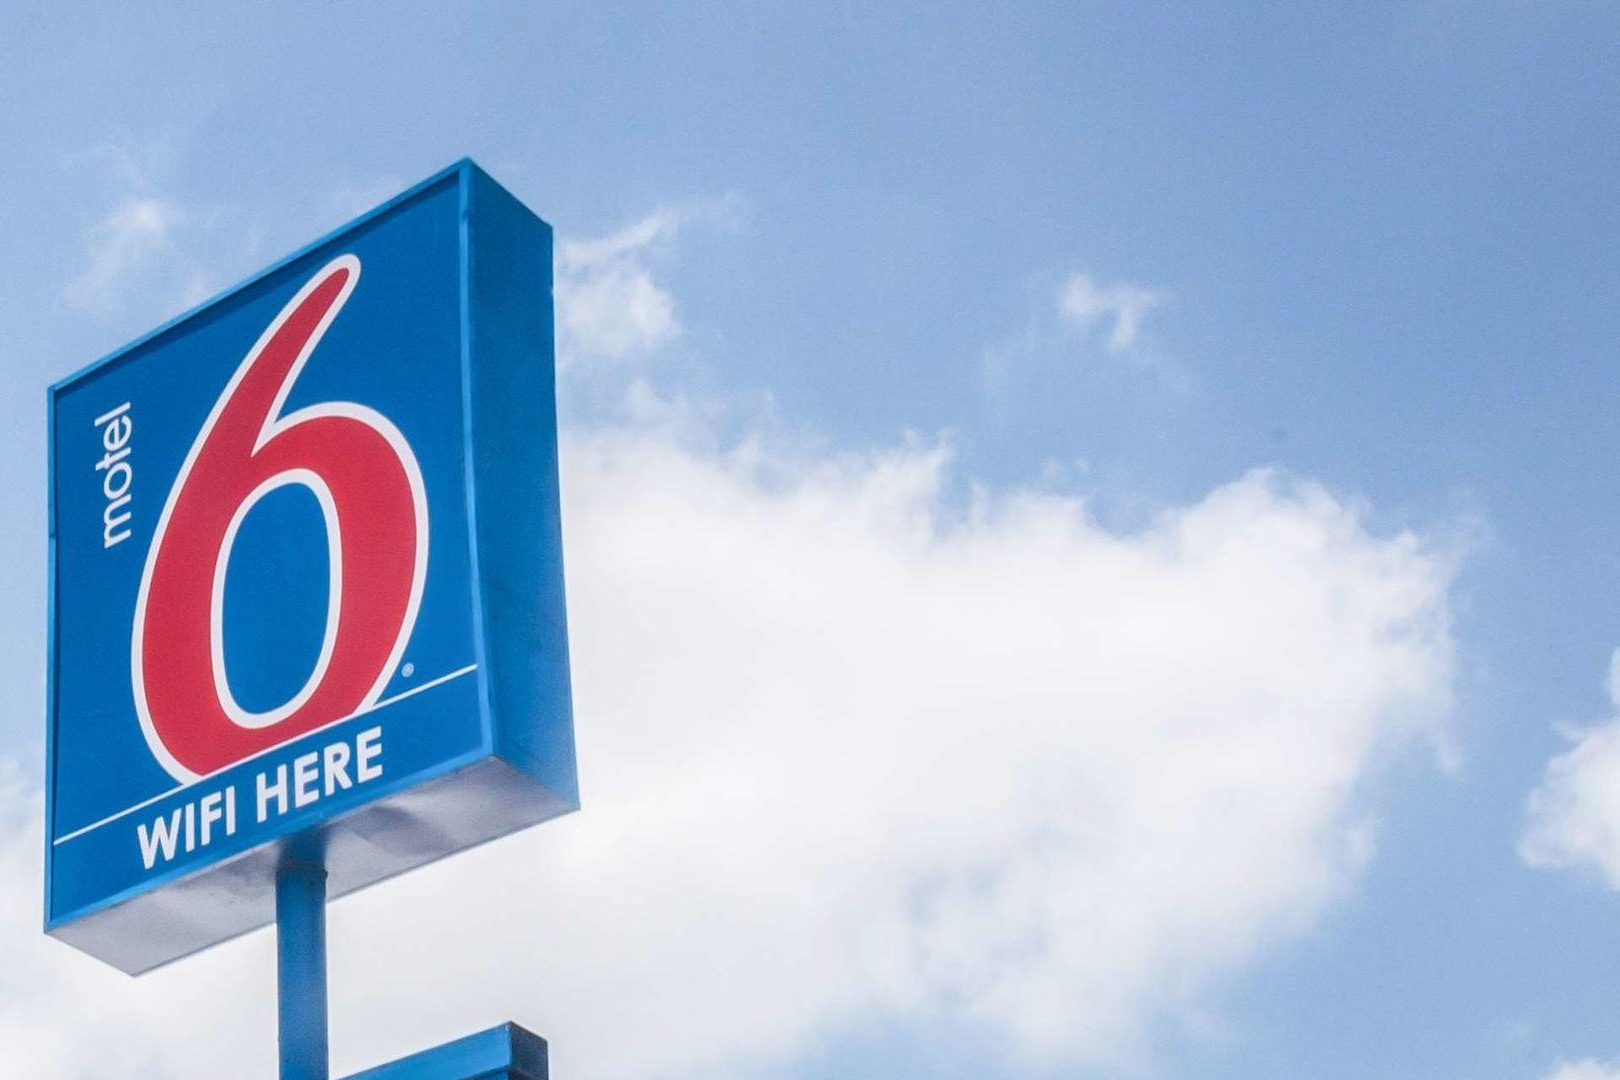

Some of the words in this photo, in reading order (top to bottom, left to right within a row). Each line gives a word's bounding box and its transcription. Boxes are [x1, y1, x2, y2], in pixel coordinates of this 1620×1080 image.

[95, 402, 132, 547] motel
[131, 254, 429, 788] 6
[137, 787, 235, 868] WIFI
[257, 727, 383, 822] HERE
